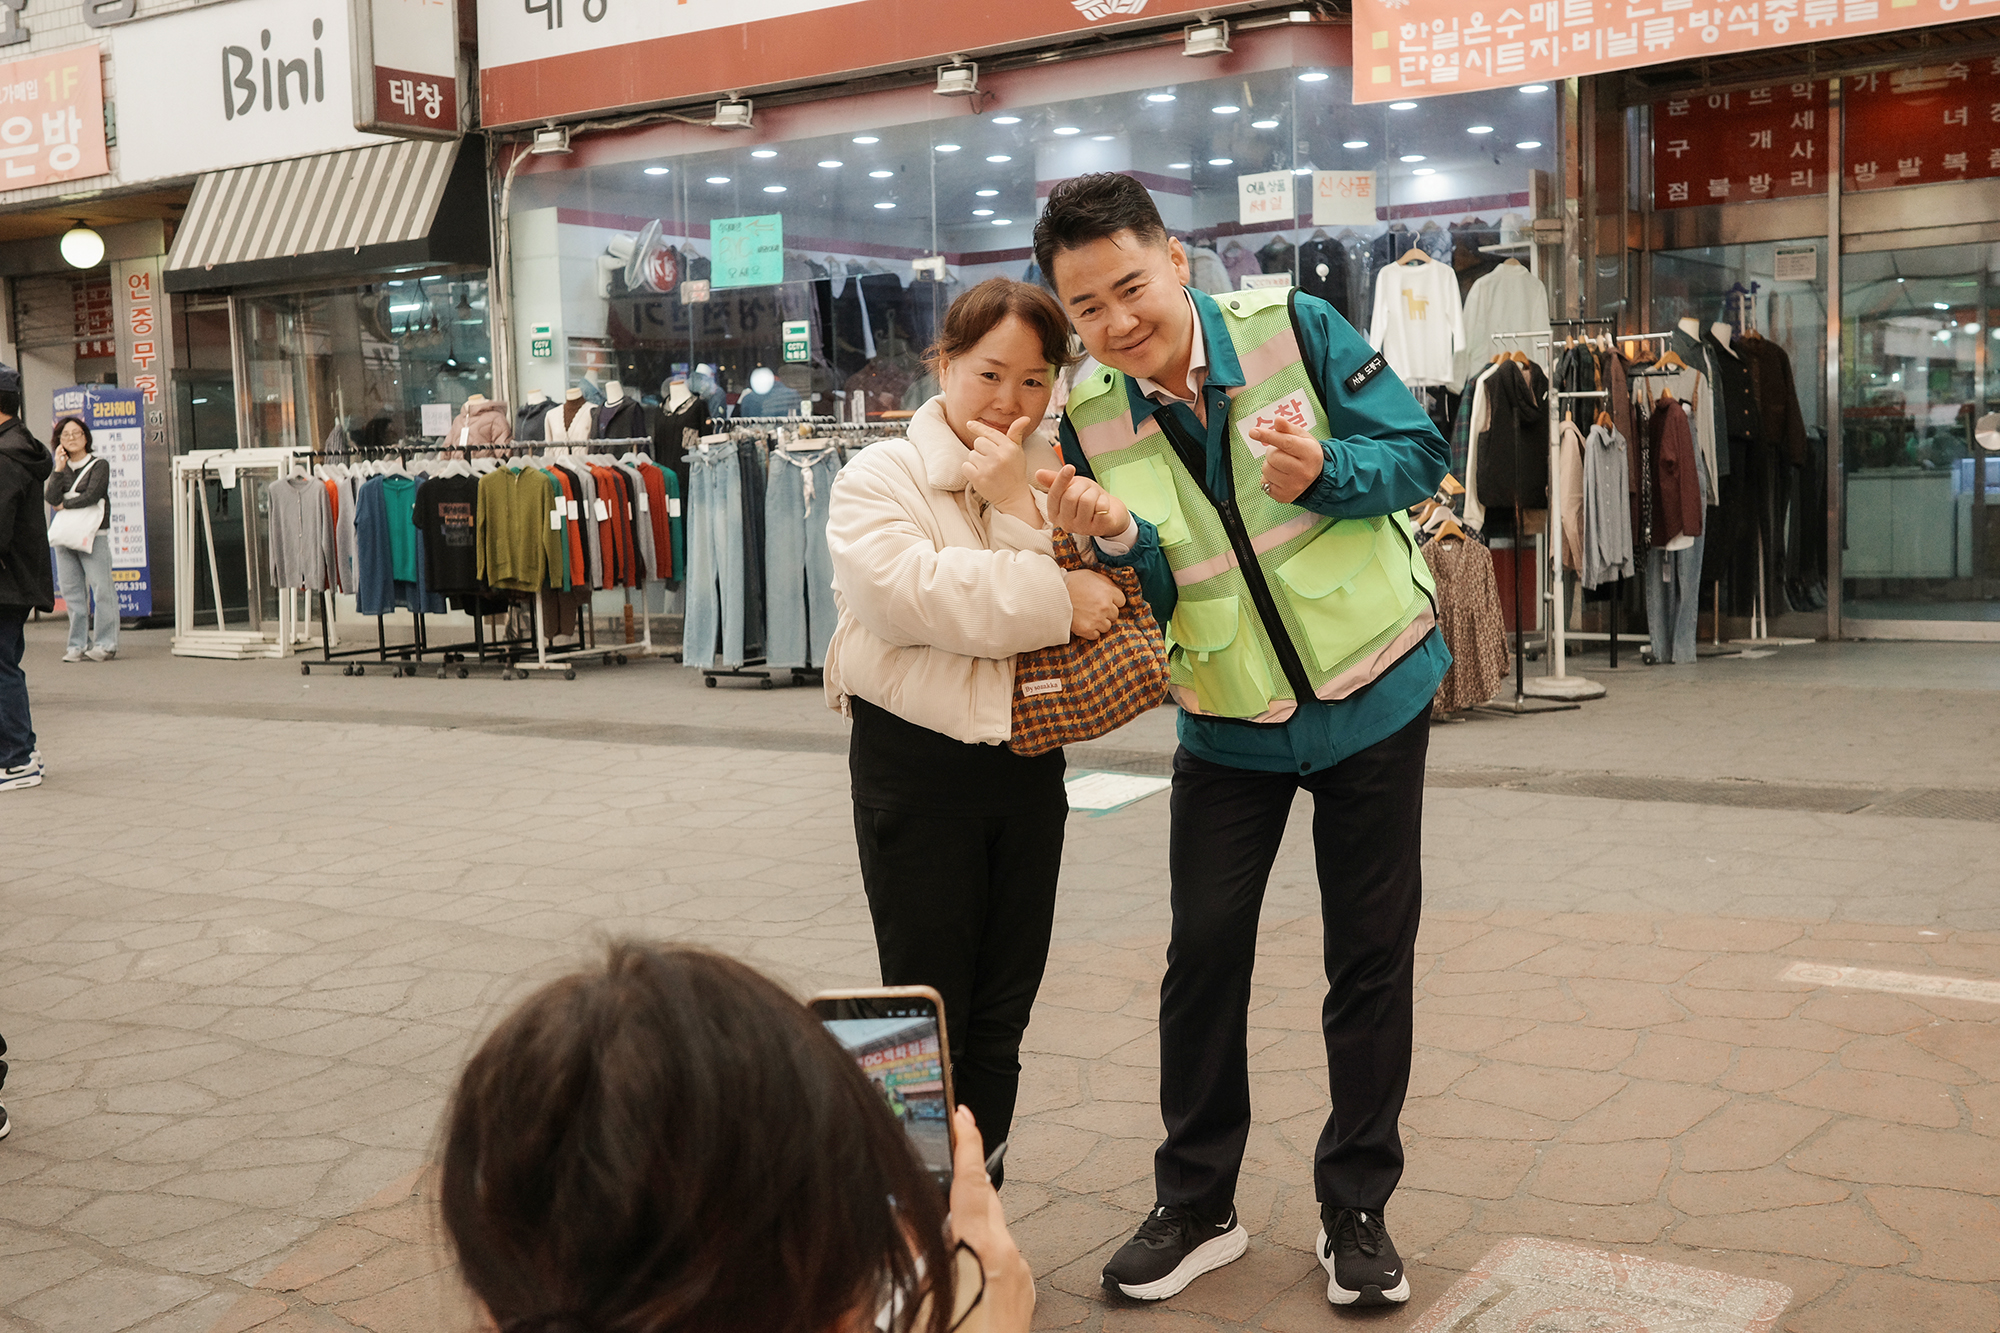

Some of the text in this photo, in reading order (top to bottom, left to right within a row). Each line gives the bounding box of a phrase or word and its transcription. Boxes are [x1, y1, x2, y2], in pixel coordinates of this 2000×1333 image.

[45, 66, 78, 102] 1F
[222, 18, 325, 120] Bini
[388, 79, 443, 119] 태창
[1318, 176, 1371, 198] 신상품
[128, 272, 157, 403] 연중무휴
[1352, 372, 1366, 387] 서울
